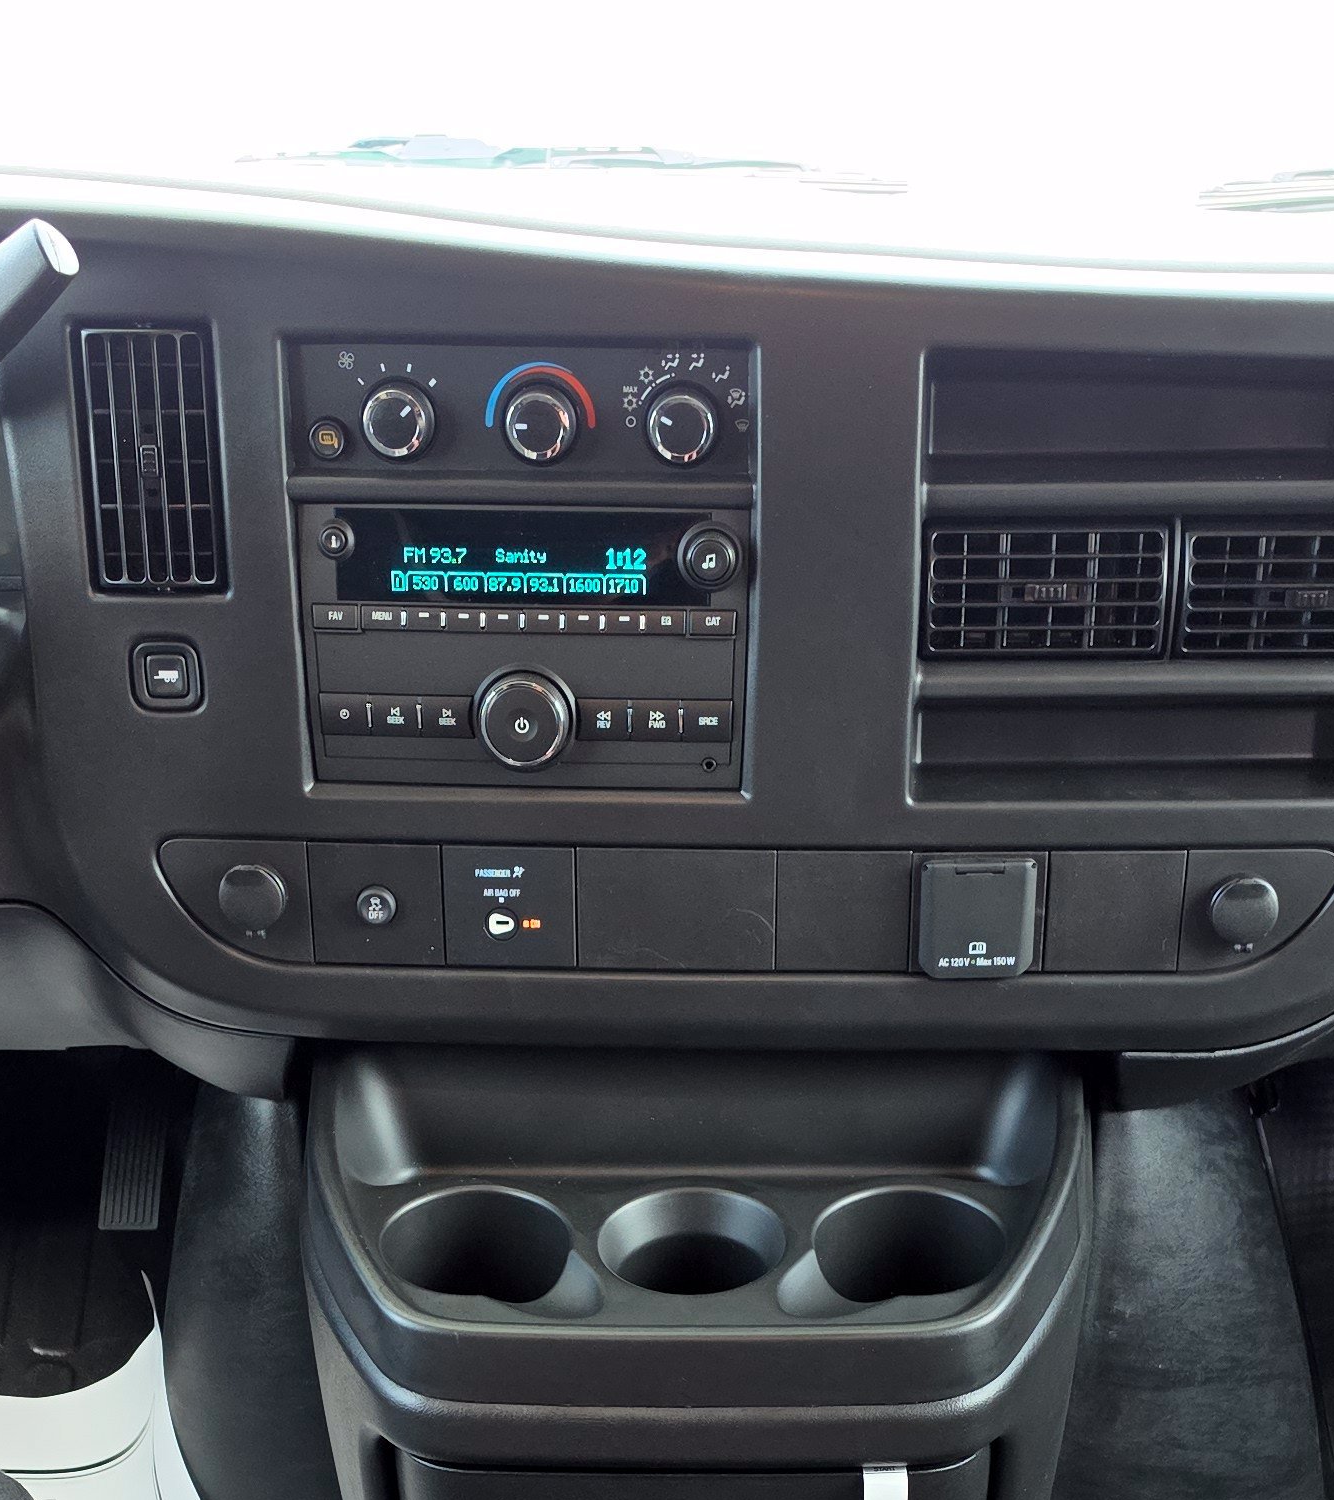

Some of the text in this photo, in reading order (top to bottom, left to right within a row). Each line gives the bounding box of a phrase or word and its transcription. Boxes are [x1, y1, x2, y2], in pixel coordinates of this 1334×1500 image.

[622, 385, 638, 393] MAX
[403, 547, 467, 564] FM 93.7
[495, 548, 547, 564] Sanity
[605, 547, 647, 570] 1:12
[412, 576, 439, 591] 530
[453, 576, 479, 591] 600
[488, 576, 522, 592] 87.9
[529, 577, 560, 593] 93.1
[569, 578, 601, 593] 1600
[608, 578, 639, 594] 1710
[328, 611, 344, 621] FAV
[372, 611, 392, 620] MENU
[705, 616, 722, 626] CAT
[596, 720, 612, 729] REV
[648, 720, 666, 729] FWD
[474, 868, 511, 878] PASSENGER
[509, 889, 521, 897] OFF
[368, 910, 384, 920] OFF
[938, 958, 950, 967] AC
[976, 957, 992, 966] Max
